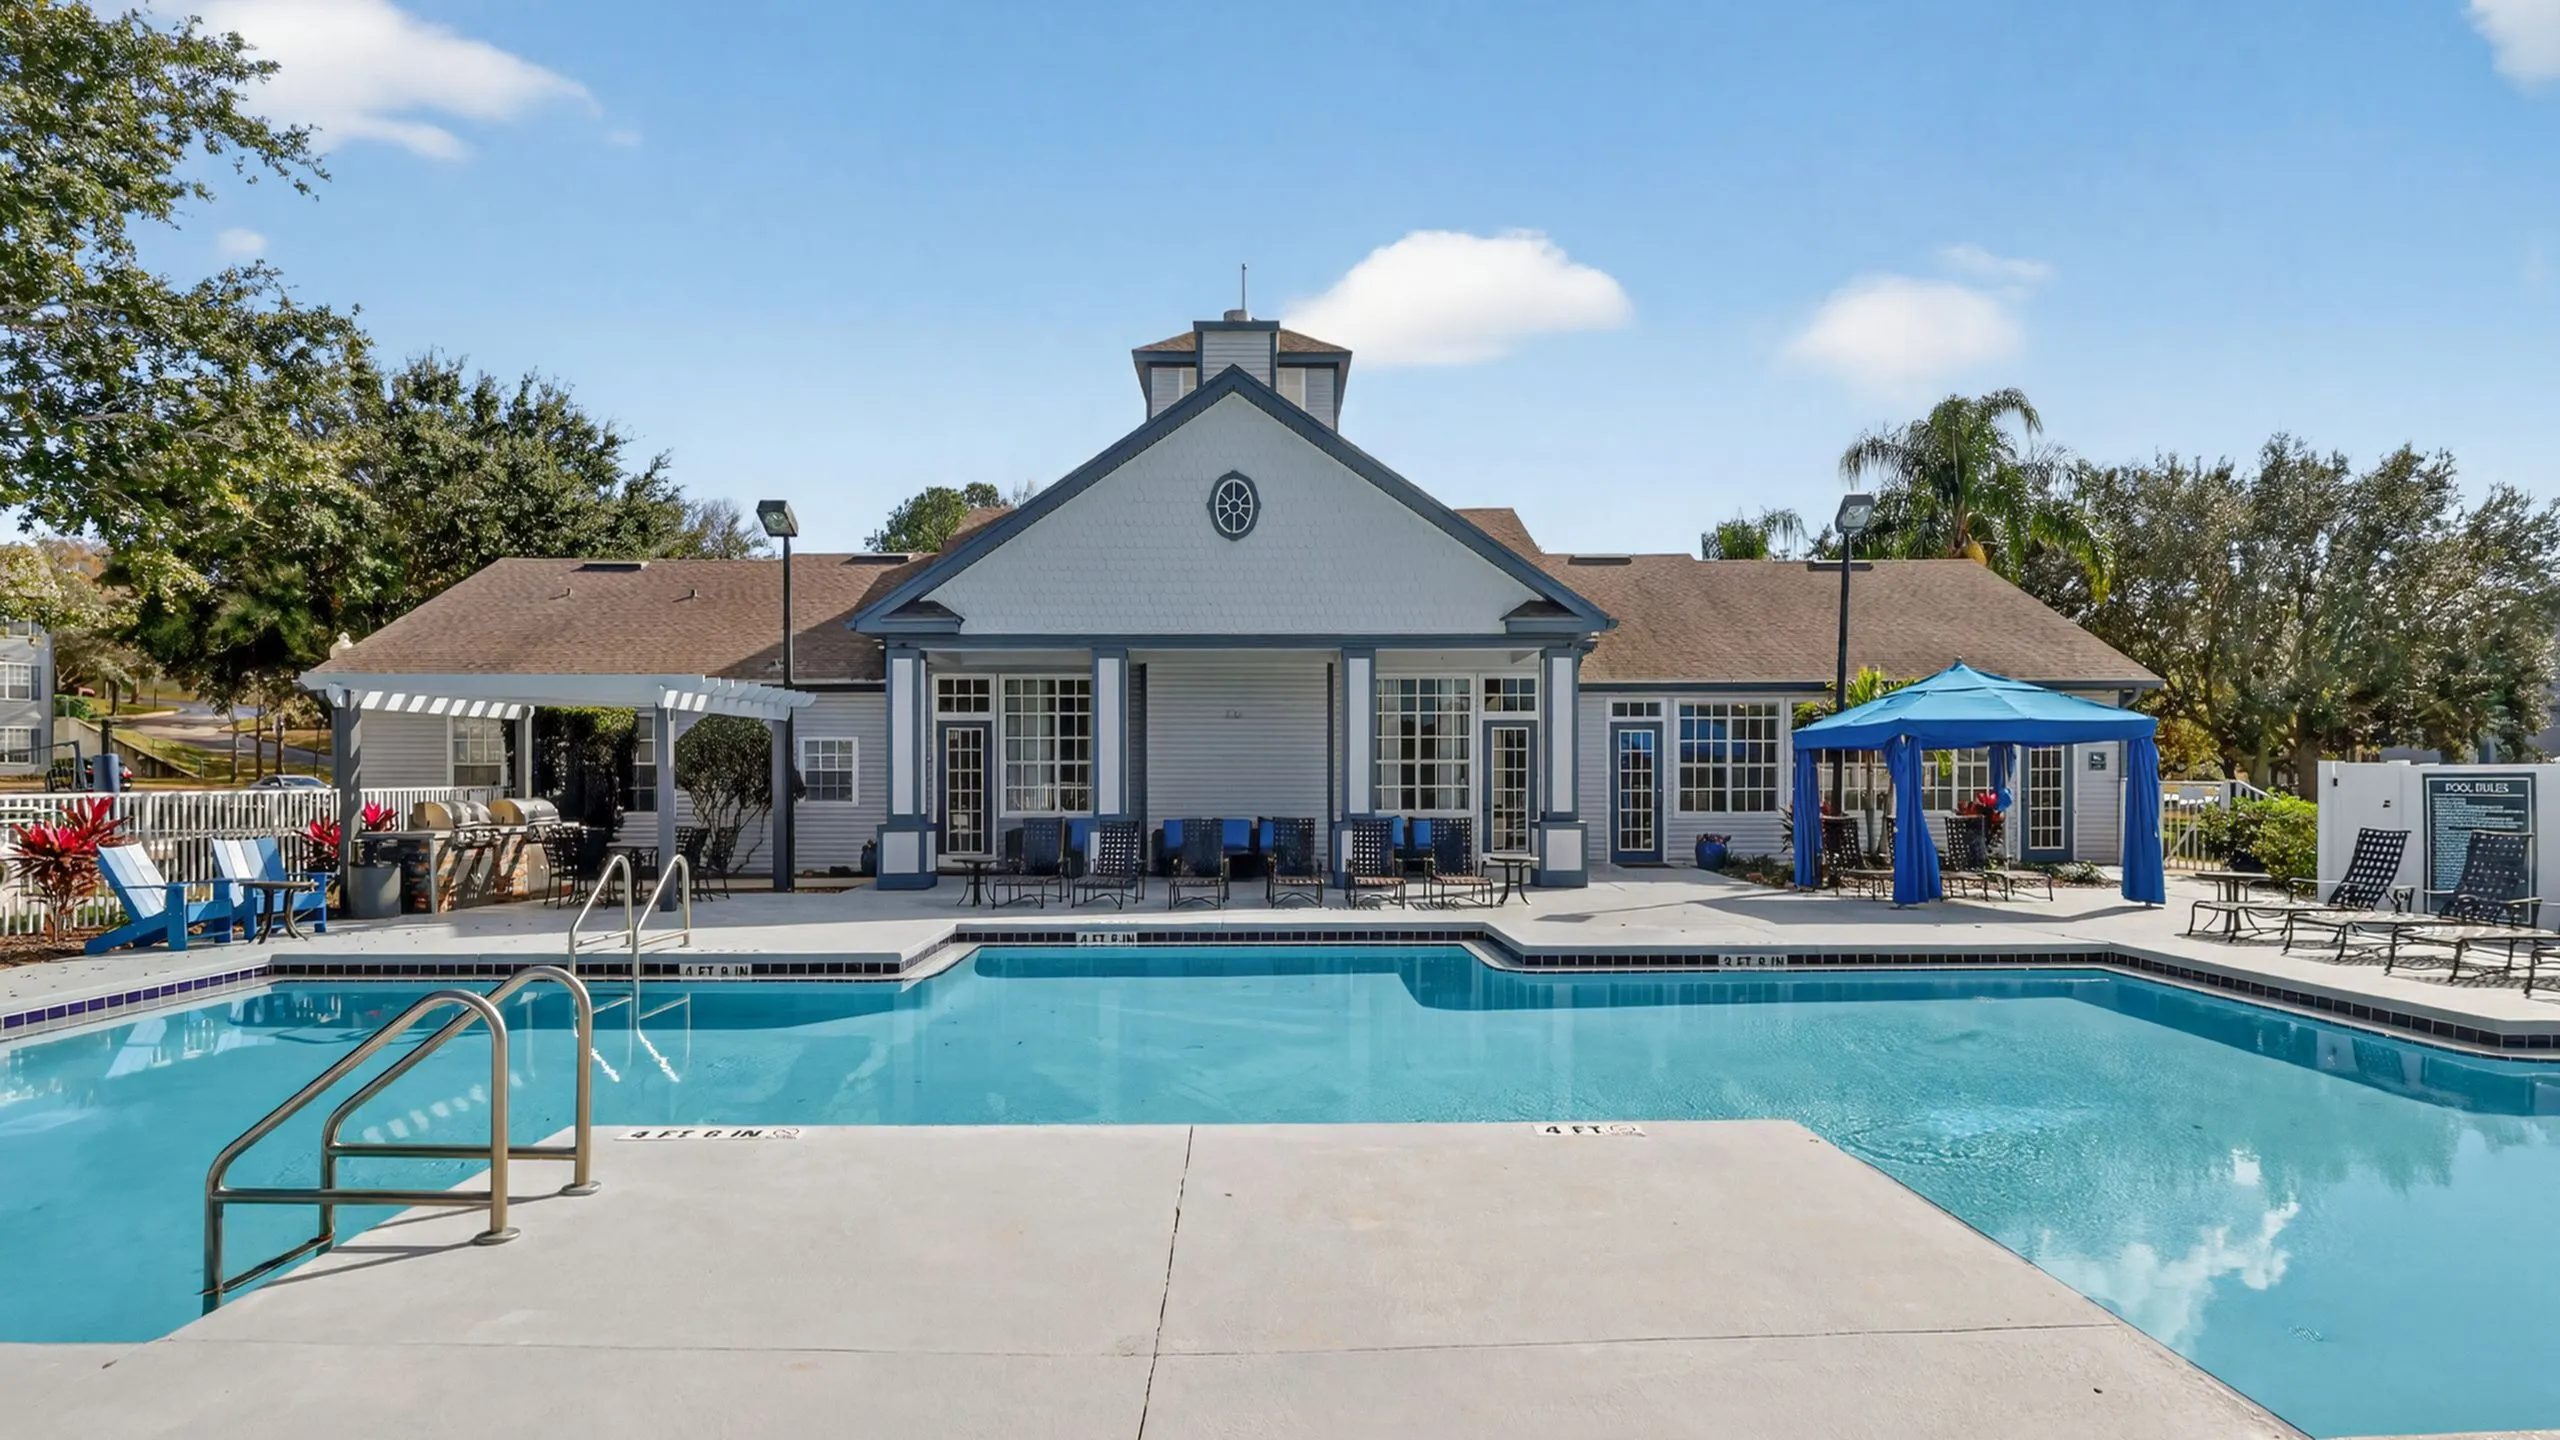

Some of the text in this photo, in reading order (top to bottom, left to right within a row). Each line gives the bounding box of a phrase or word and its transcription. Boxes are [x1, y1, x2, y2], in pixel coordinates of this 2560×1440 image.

[2445, 782, 2509, 793] POOL RULES
[735, 965, 748, 976] IN
[657, 1130, 695, 1139] FT
[731, 1129, 764, 1138] IN
[1571, 1125, 1601, 1134] FT
